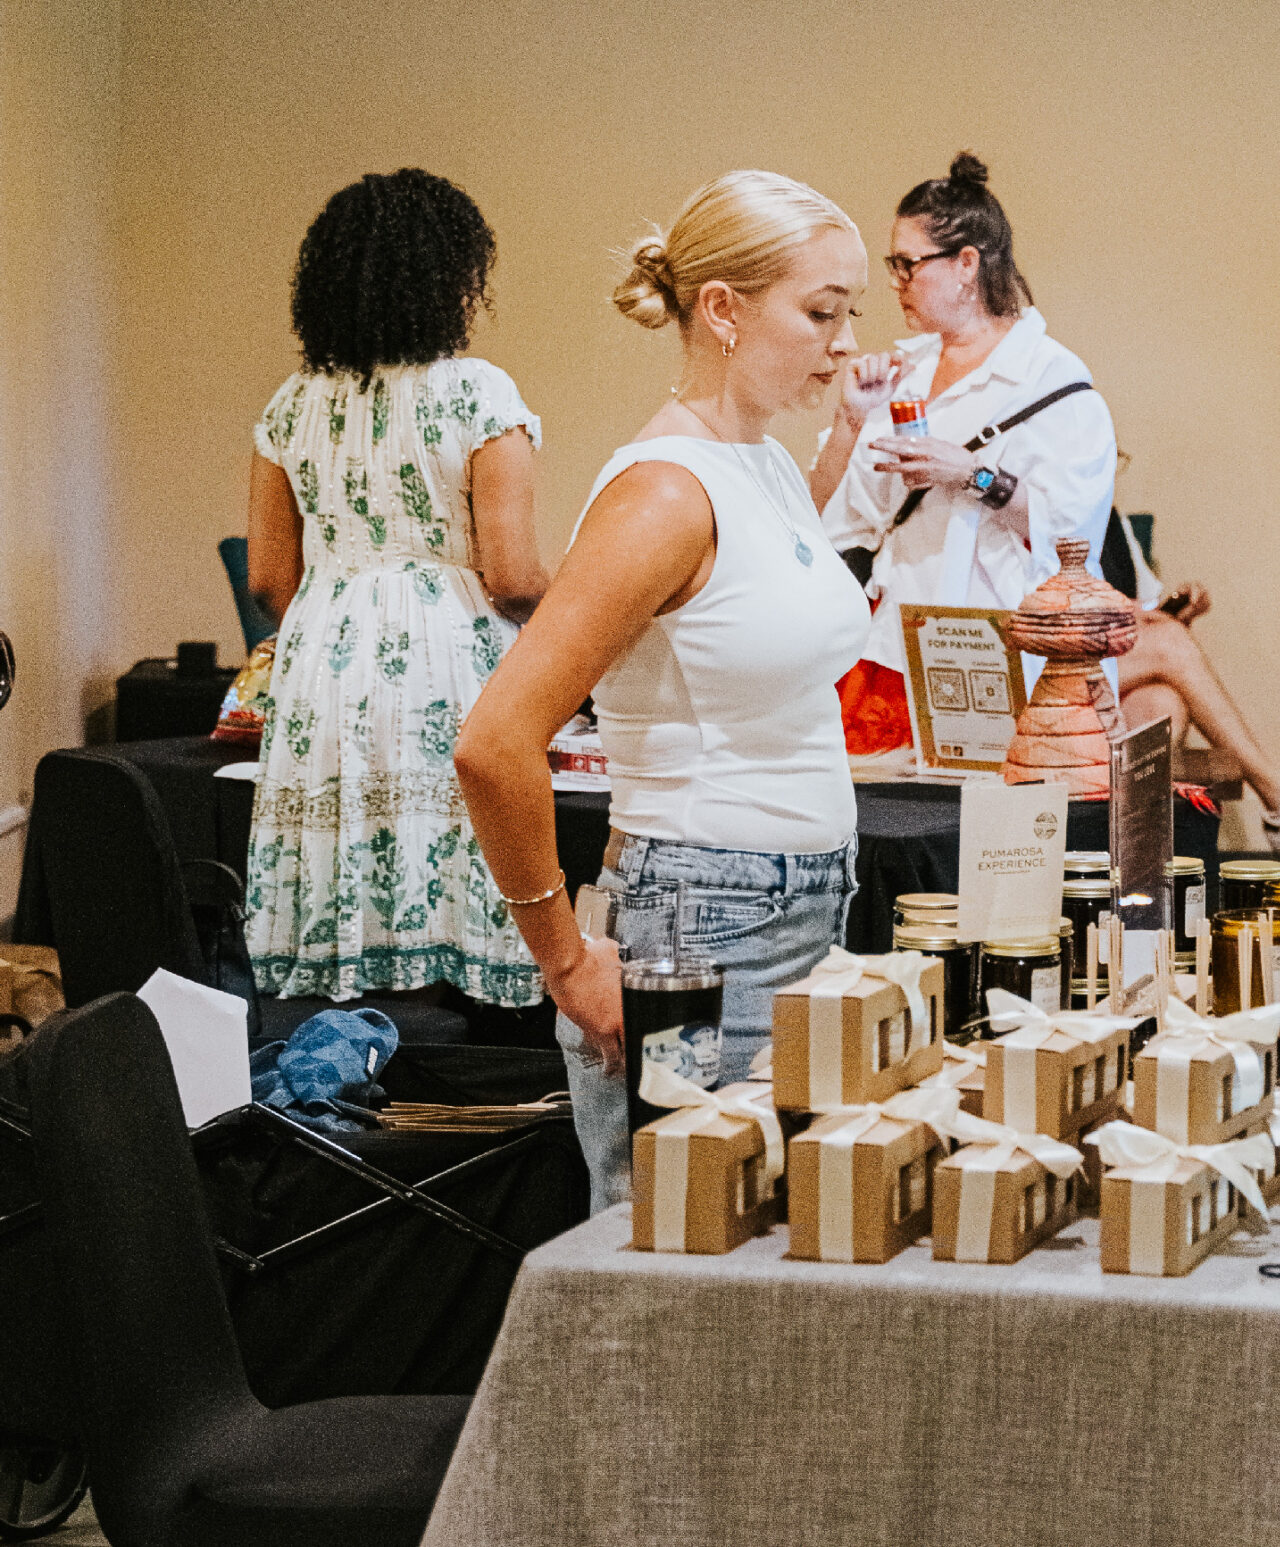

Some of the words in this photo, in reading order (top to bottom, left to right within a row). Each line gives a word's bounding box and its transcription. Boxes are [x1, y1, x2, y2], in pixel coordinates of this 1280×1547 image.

[936, 626, 967, 637] SCAN
[968, 628, 983, 639] ME
[927, 640, 947, 649] FOR
[949, 641, 996, 651] PAYMENT
[982, 847, 1044, 858] PUMAROSA
[978, 858, 1047, 871] EXPERIENCE
